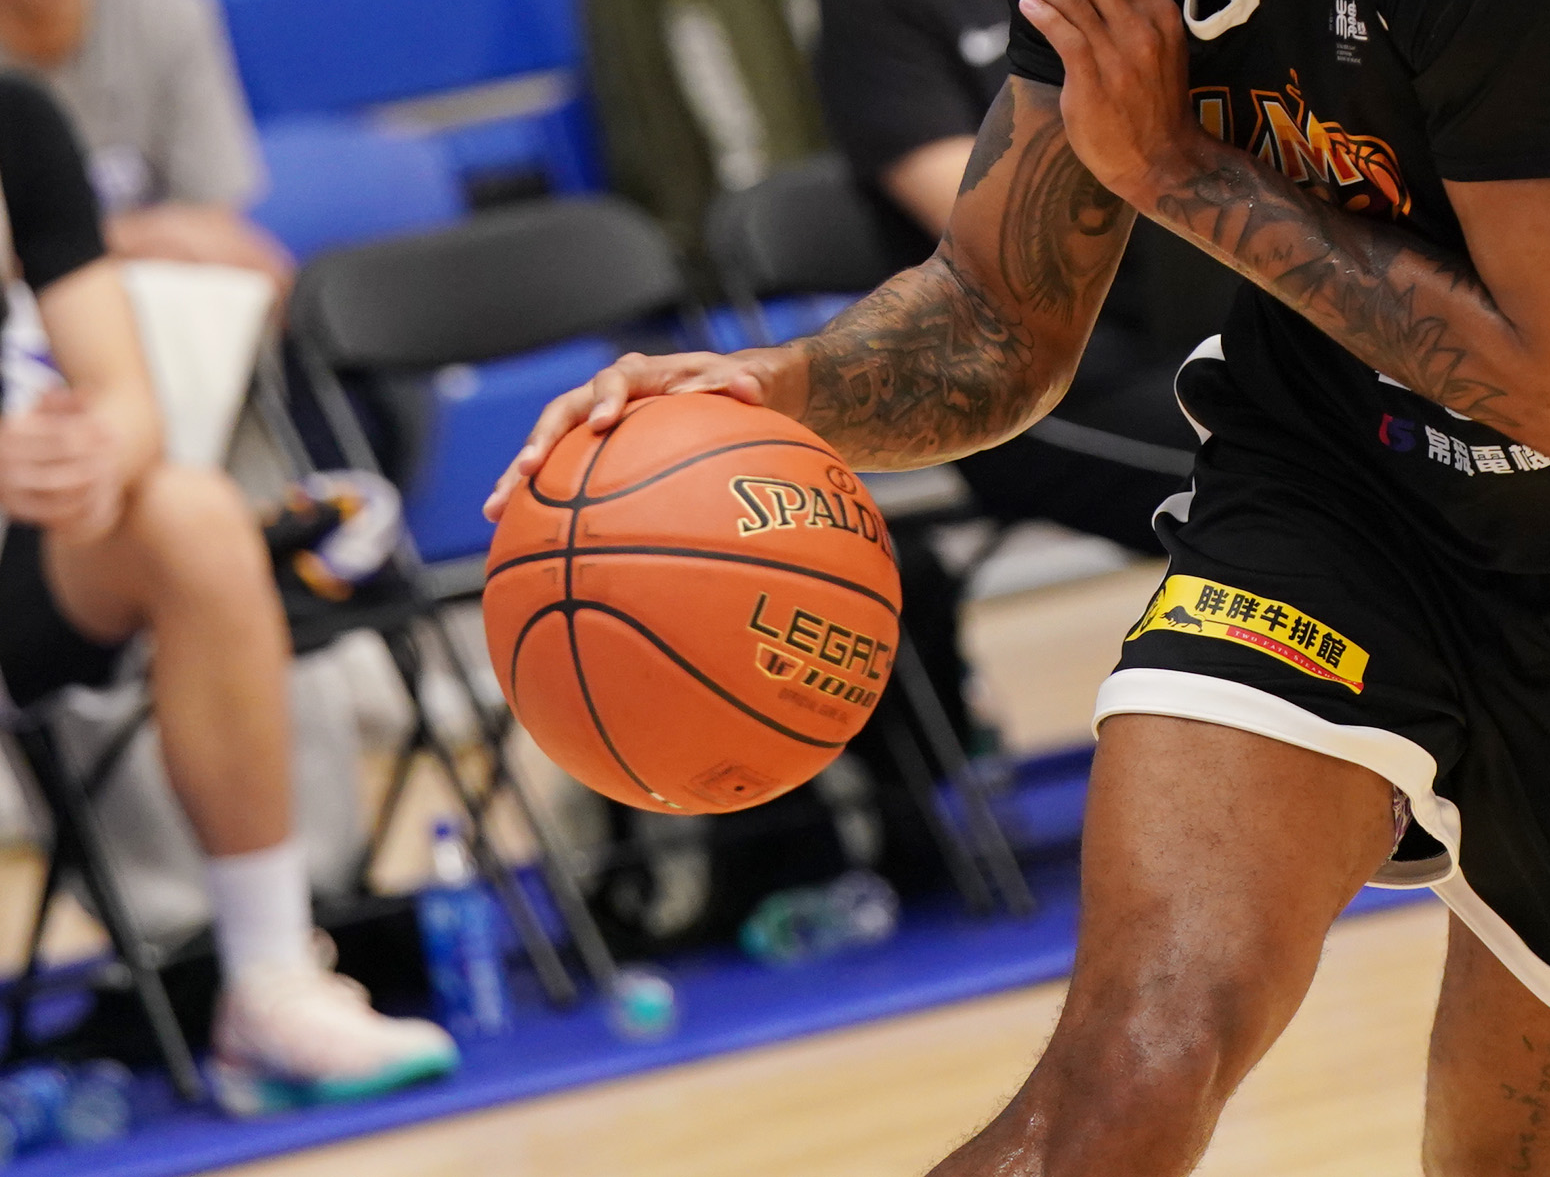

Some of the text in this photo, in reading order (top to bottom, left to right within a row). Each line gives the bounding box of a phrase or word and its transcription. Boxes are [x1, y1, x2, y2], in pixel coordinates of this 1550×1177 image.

[729, 475, 896, 564] SPALD
[747, 591, 893, 680] LEGAC
[1195, 584, 1347, 669] 胖胖牛排館
[1234, 630, 1258, 643] TWO
[1263, 640, 1289, 657] FATS
